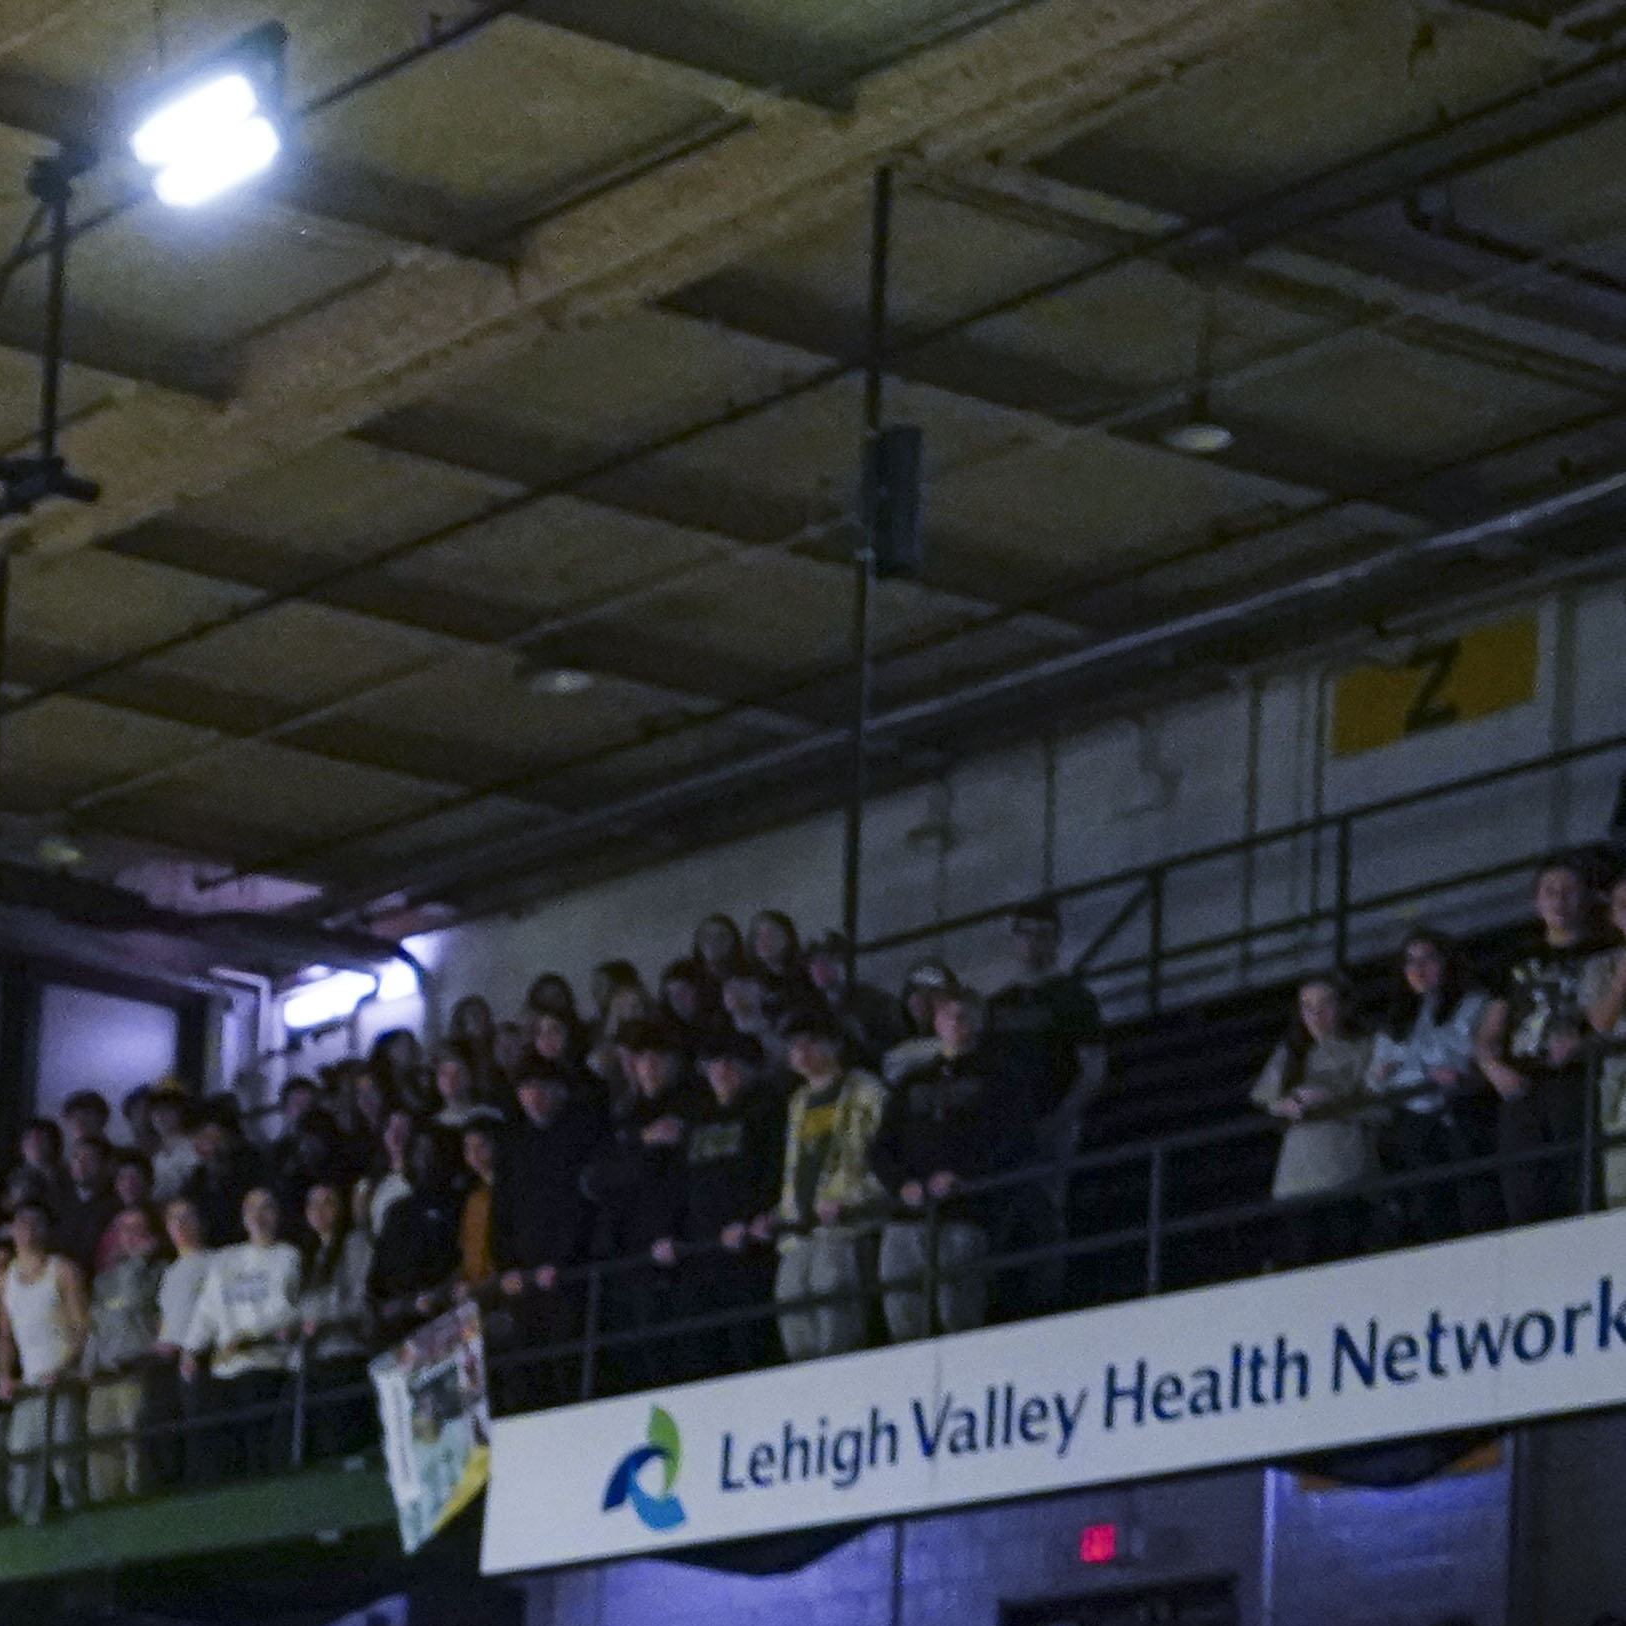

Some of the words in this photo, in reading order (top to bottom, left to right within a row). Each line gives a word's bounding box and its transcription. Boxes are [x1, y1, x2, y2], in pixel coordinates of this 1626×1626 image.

[719, 1411, 900, 1495] Lehigh
[909, 1384, 1091, 1461] Valley
[1103, 1336, 1312, 1432] Health
[1330, 1276, 1626, 1396] Network
